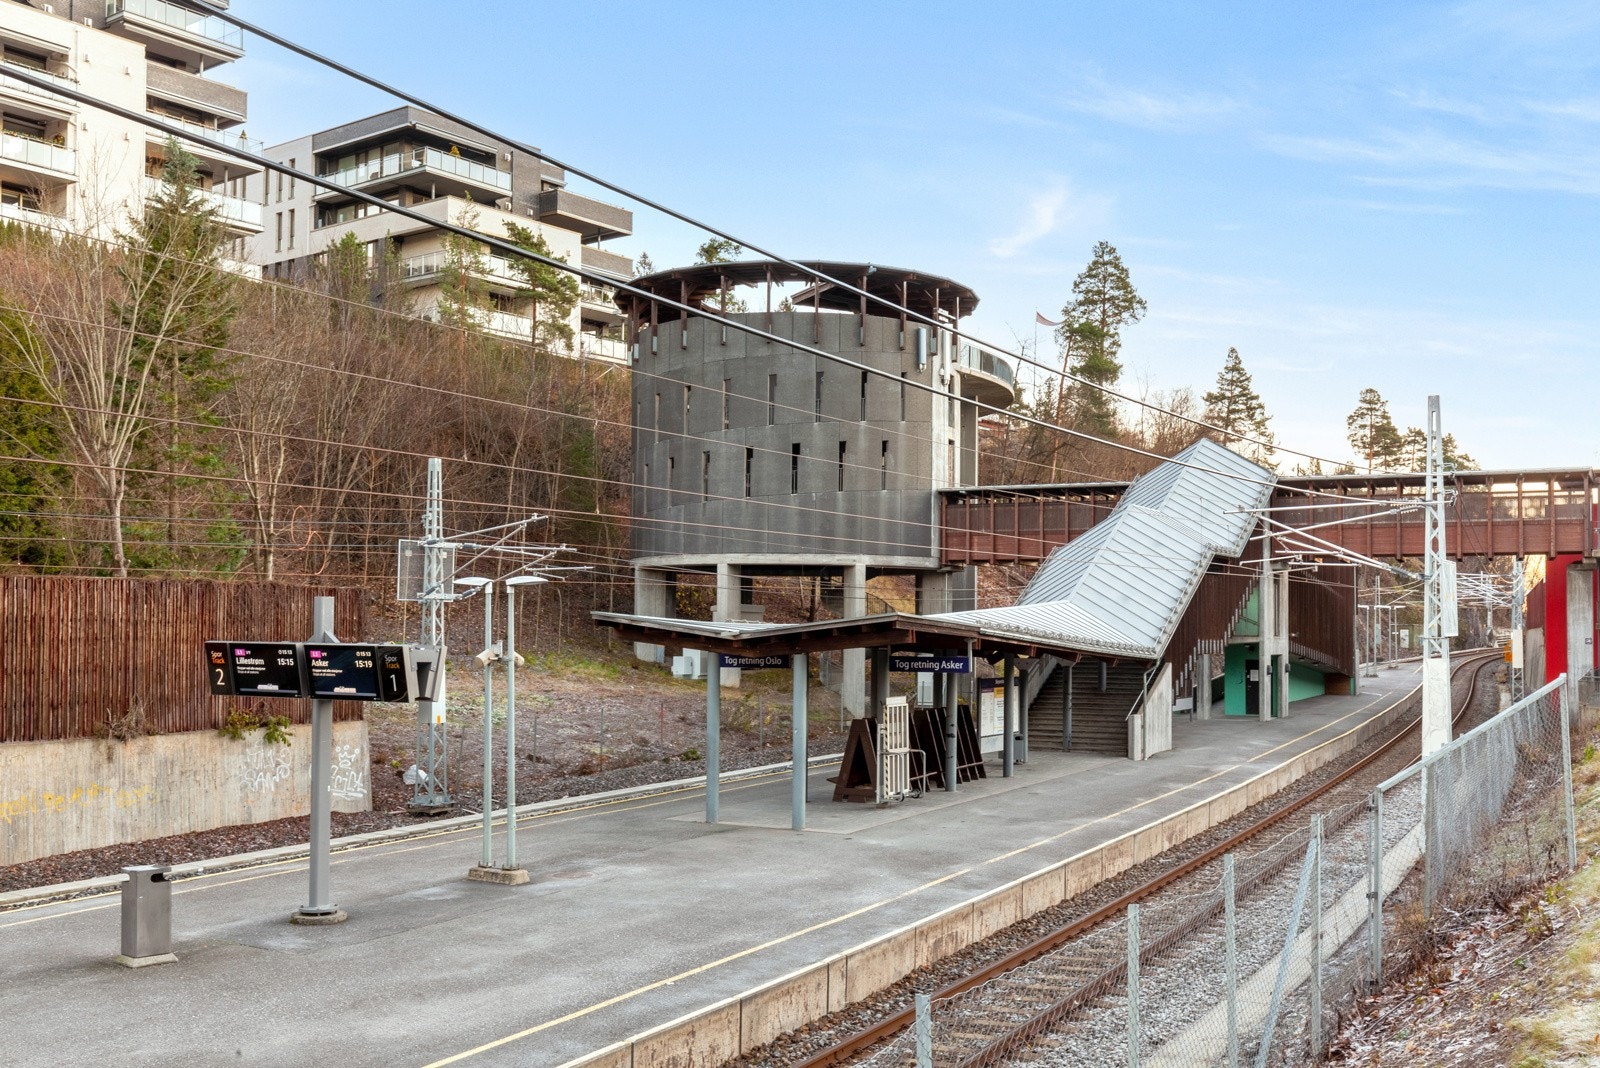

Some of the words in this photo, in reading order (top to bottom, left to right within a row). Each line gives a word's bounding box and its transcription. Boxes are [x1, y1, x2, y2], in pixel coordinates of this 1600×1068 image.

[211, 651, 223, 660] Spor
[384, 655, 398, 664] Spor
[235, 657, 265, 665] Lillestrøm
[277, 658, 294, 666] 15:15
[311, 659, 329, 667] Asker
[354, 660, 373, 668] 15:19
[386, 661, 401, 669] Track
[724, 656, 738, 666] Tog
[738, 657, 765, 666] retning
[765, 656, 782, 665] Oslo
[895, 659, 909, 670] Tog
[910, 660, 940, 671] retning
[940, 660, 964, 669] Asker
[215, 668, 226, 686] 2
[389, 673, 397, 692] 1
